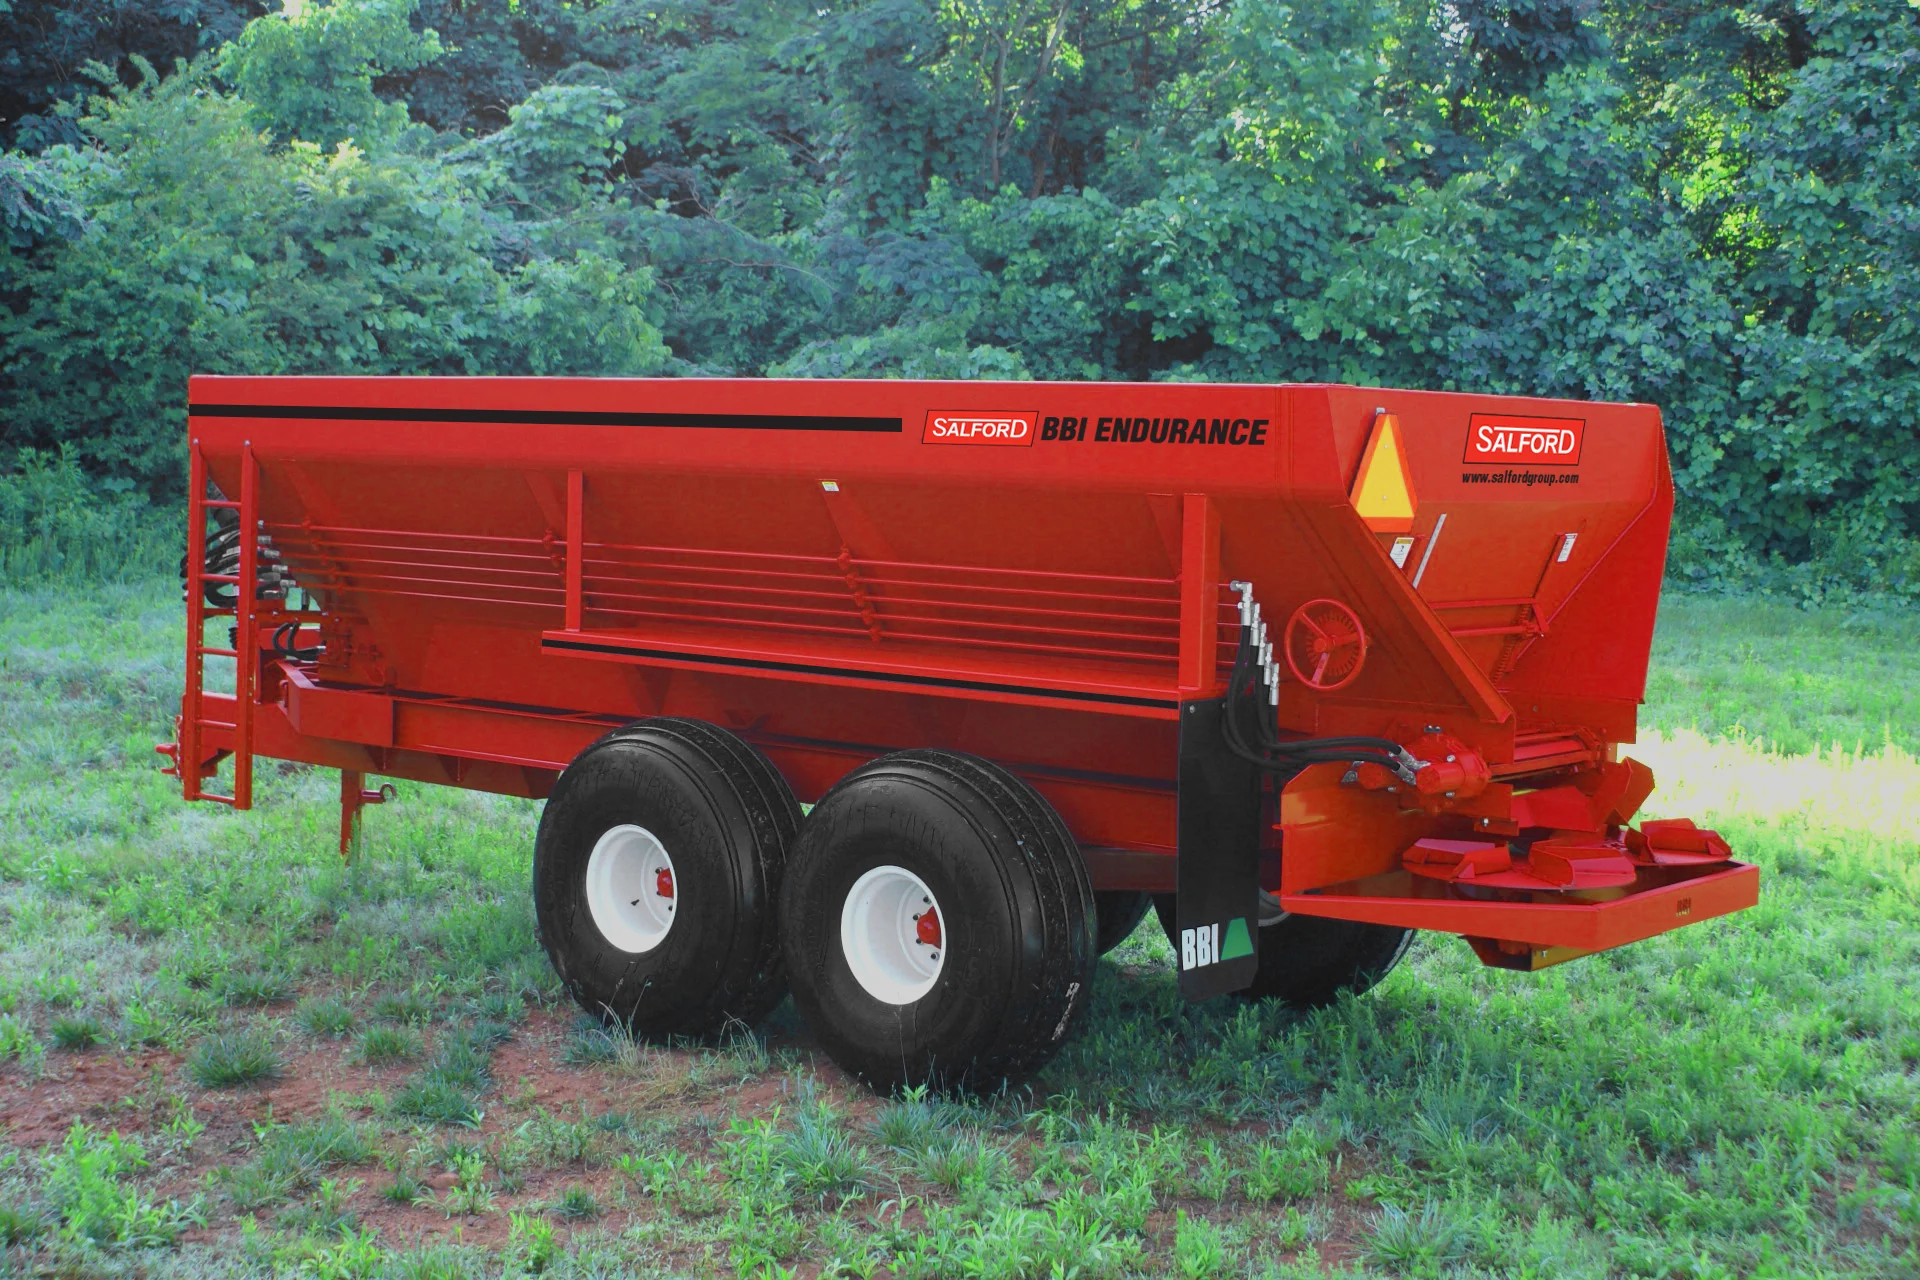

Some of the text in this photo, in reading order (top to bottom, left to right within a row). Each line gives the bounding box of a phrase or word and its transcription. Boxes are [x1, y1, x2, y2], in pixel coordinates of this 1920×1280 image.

[932, 417, 1027, 438] SALFORD
[1041, 416, 1269, 445] BBI ENDURANCE
[1476, 425, 1575, 454] SALFORD
[1462, 470, 1579, 486] www.salfordgroup.com
[1181, 923, 1220, 971] BBI
